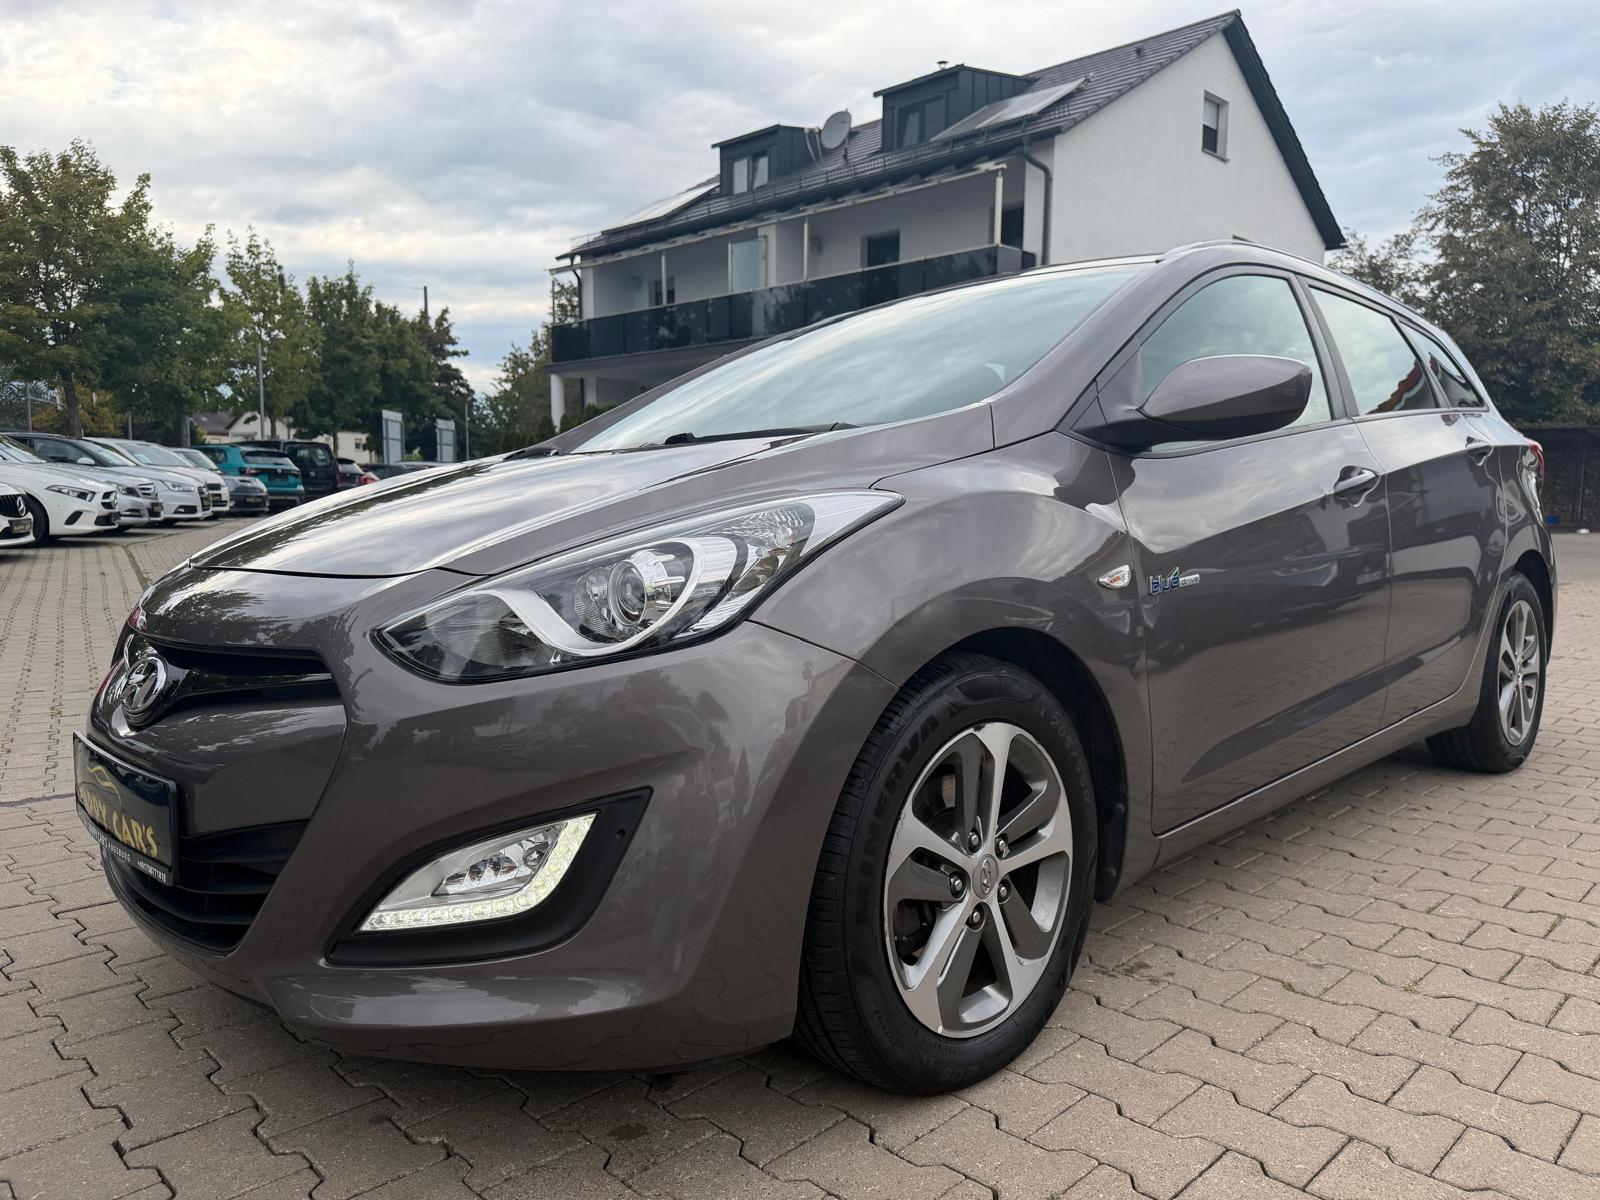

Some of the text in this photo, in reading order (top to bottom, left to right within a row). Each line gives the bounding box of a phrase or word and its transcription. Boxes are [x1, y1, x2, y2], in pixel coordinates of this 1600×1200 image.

[1150, 567, 1199, 595] blue drive
[112, 810, 159, 858] CAR'S
